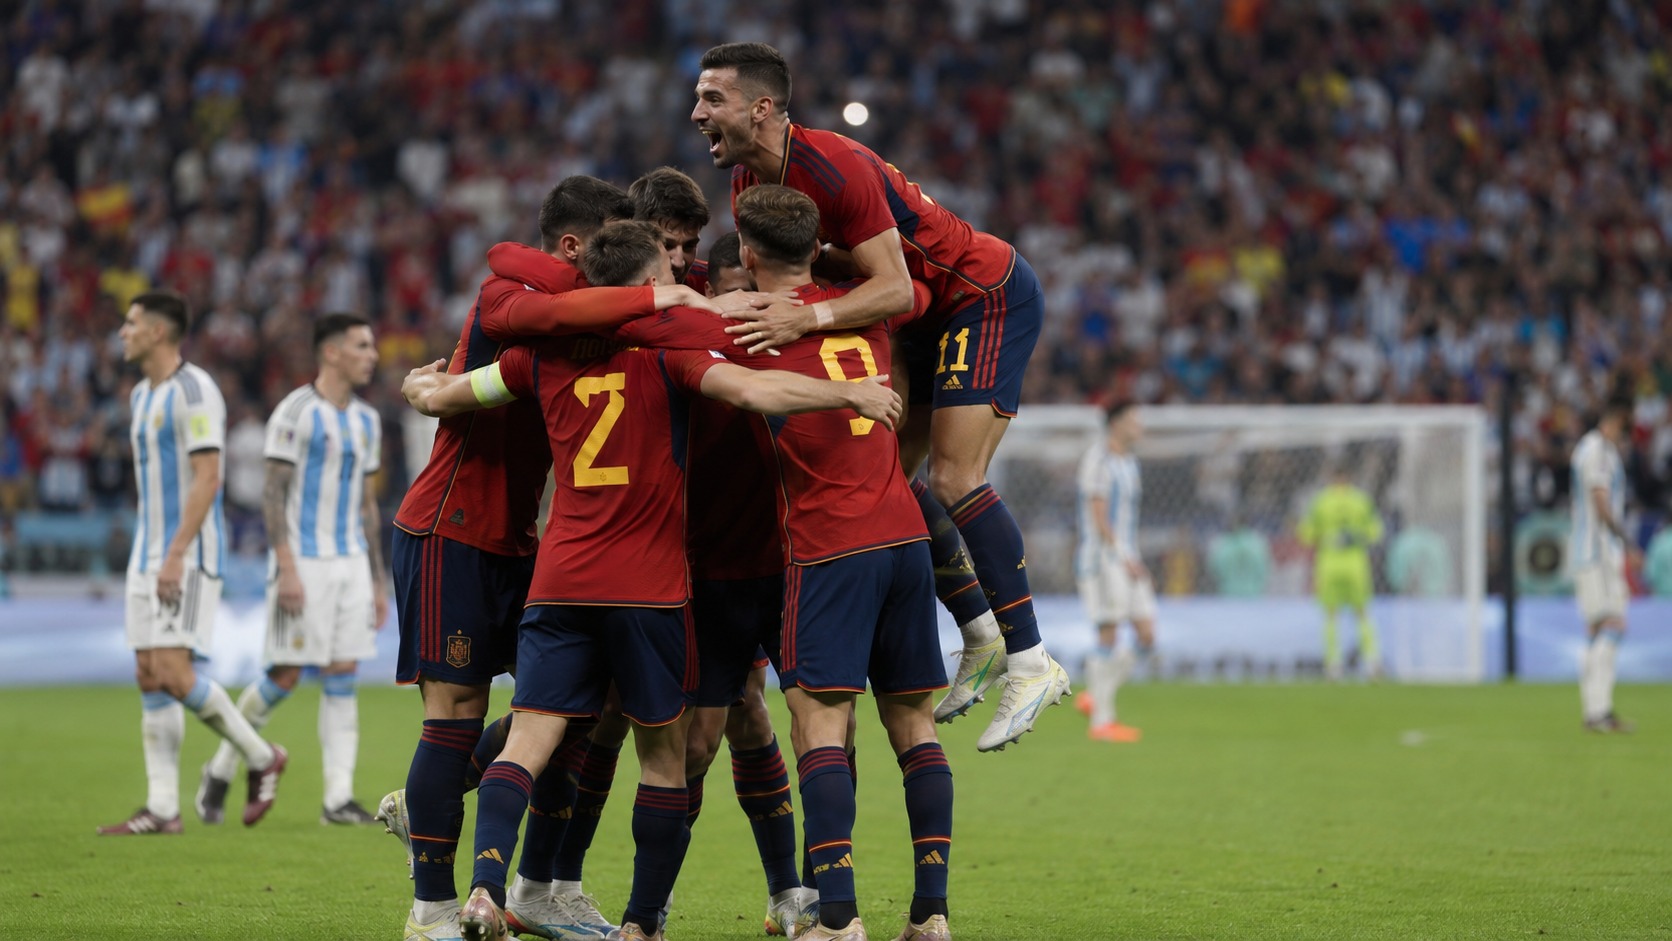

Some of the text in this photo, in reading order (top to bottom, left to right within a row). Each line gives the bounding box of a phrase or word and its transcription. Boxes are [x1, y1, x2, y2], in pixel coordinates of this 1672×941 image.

[819, 333, 879, 436] 9
[936, 327, 970, 375] 11
[573, 372, 630, 488] 2
